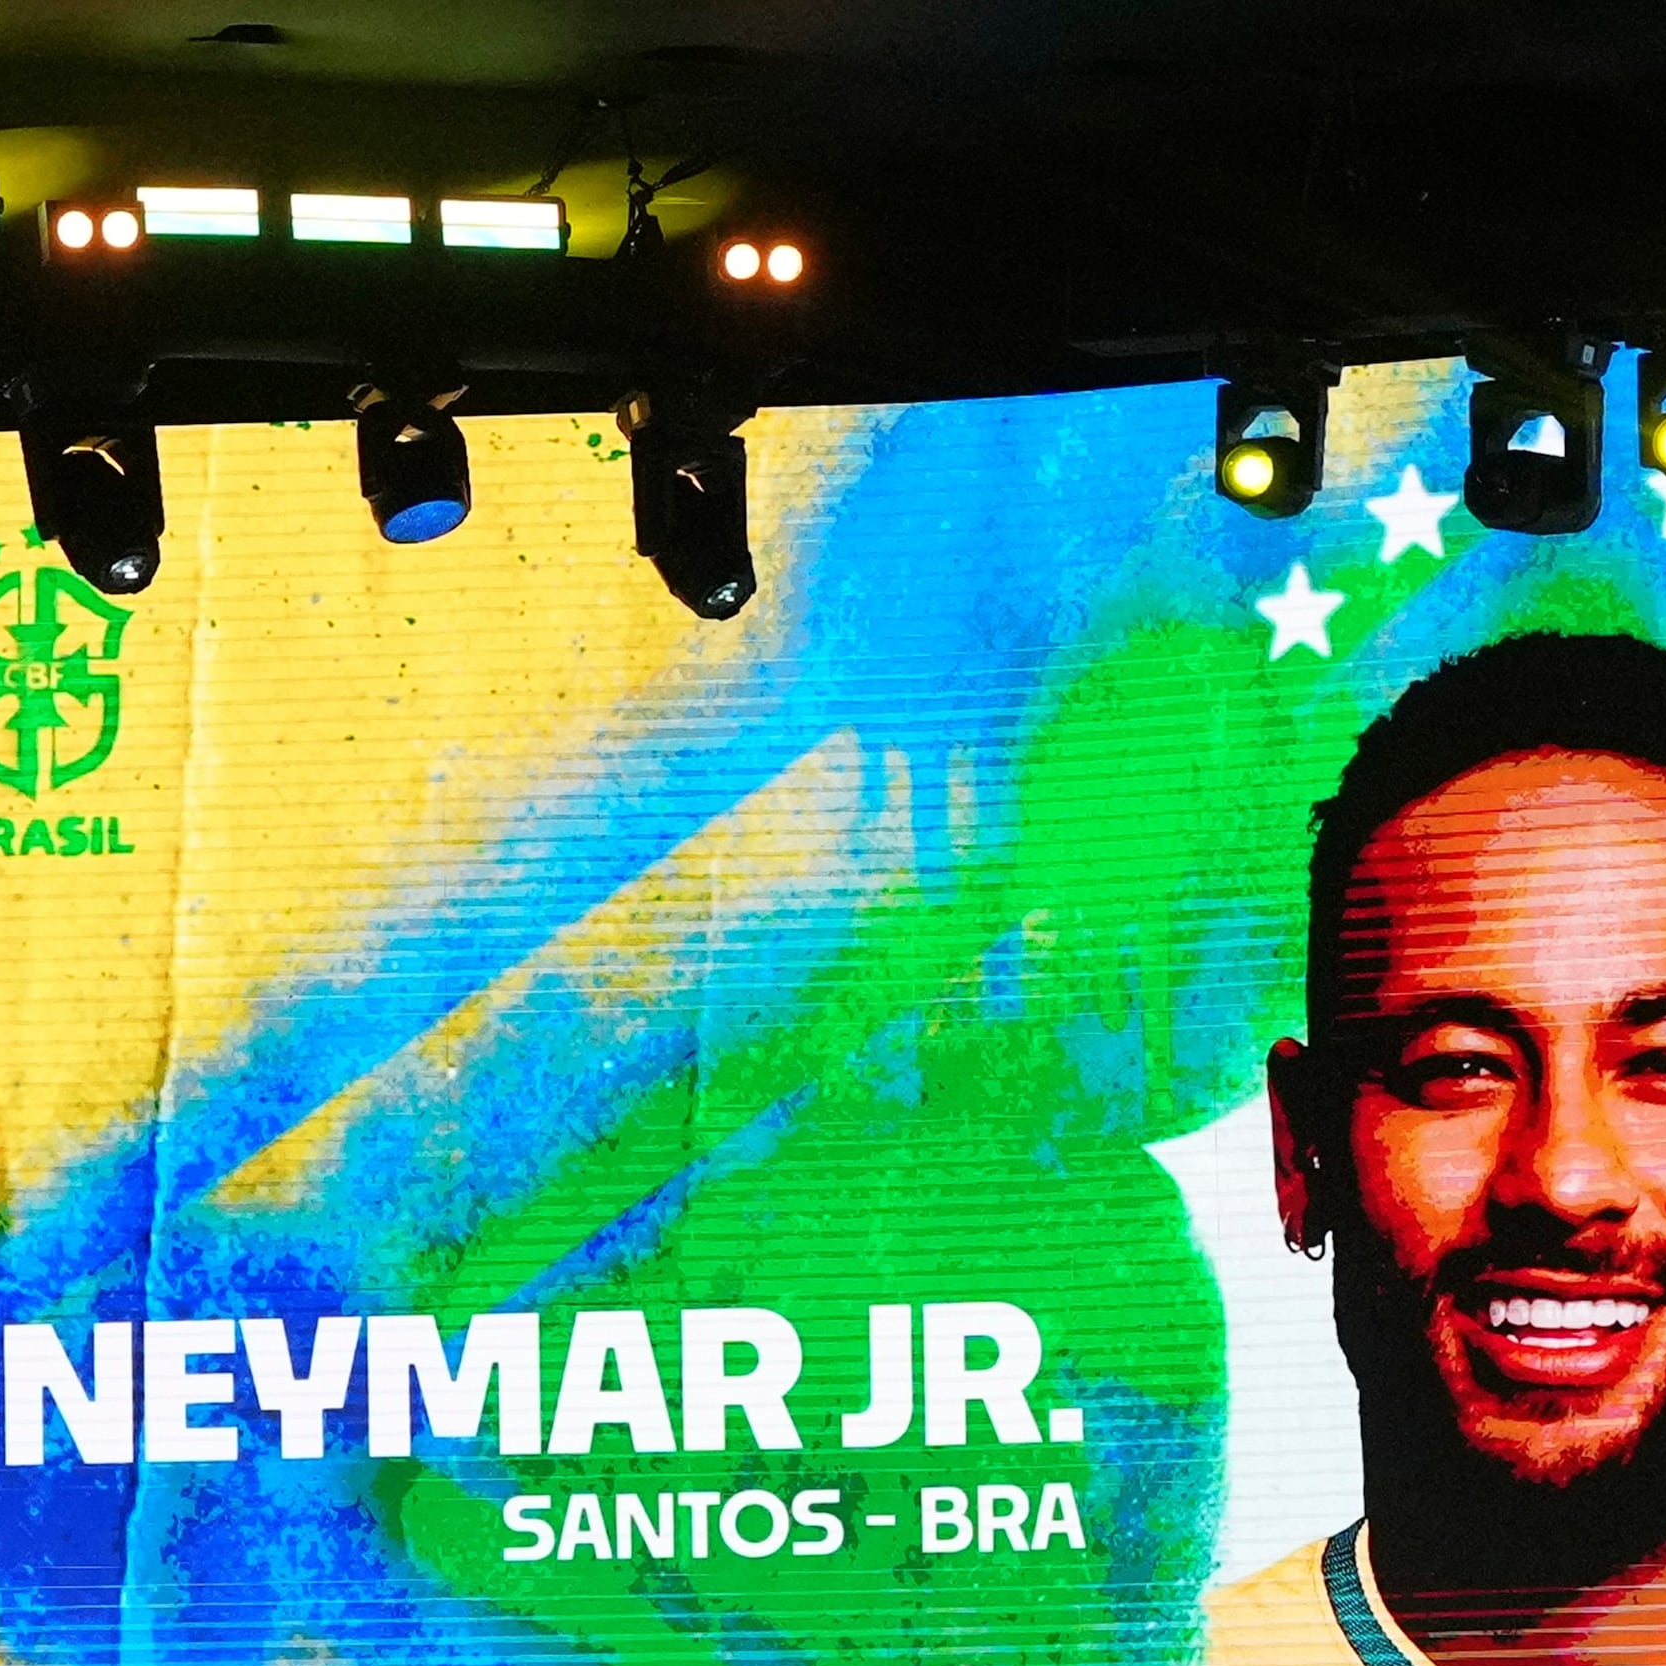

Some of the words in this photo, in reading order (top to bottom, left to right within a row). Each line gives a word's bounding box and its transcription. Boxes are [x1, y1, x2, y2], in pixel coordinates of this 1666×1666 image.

[2, 662, 66, 691] CBF
[2, 1306, 802, 1467] NEYMAR
[841, 1303, 1083, 1448] JR.
[502, 1487, 845, 1562] SANTOS
[866, 1516, 896, 1529] -
[922, 1483, 1084, 1555] BRA
